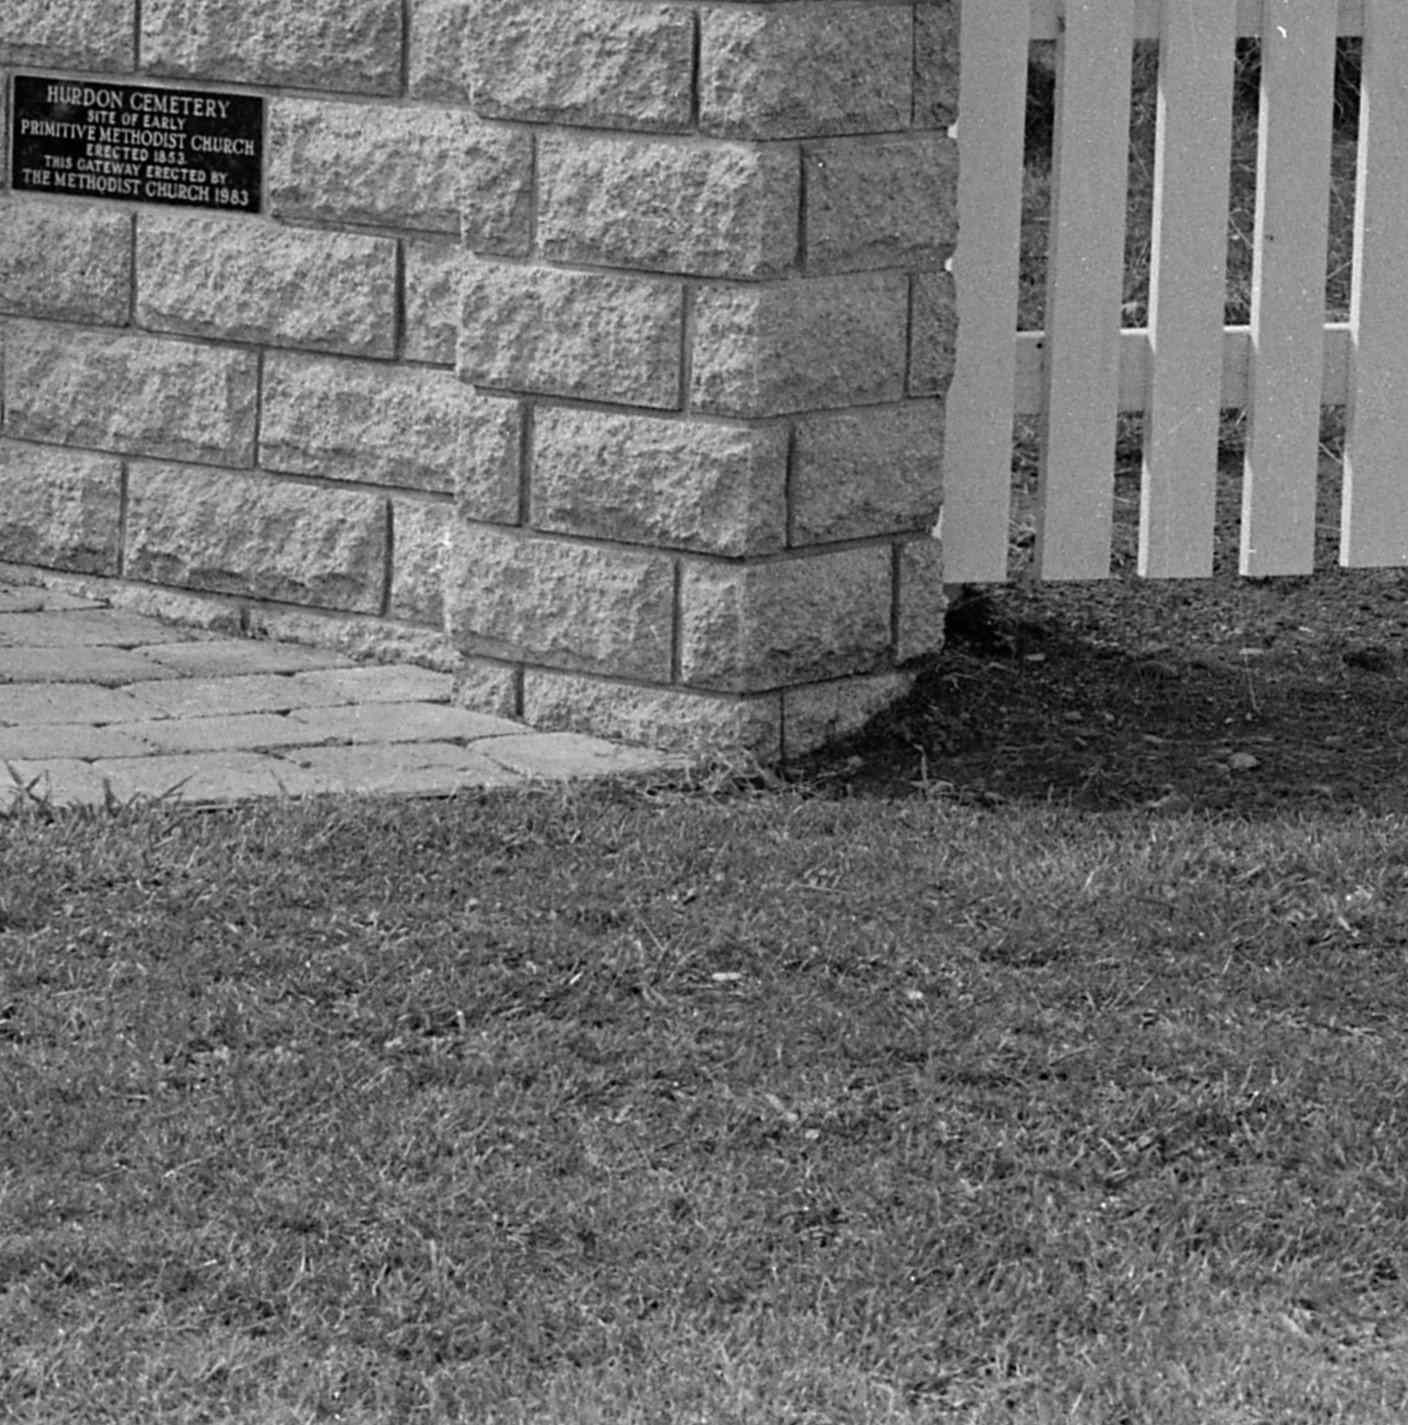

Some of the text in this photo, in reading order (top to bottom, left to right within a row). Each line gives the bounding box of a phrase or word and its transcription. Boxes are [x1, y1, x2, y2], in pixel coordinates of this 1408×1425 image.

[47, 85, 231, 118] HURDON CEMETERY
[87, 110, 185, 131] SITE OF EARLY
[21, 119, 255, 156] PRIMITIVE METHODIST CHURCH
[86, 144, 149, 162] ERECTED
[44, 155, 229, 184] THIS GATEWAY ERECTED BY
[23, 168, 249, 207] THE METHODIST CHURCH 1983
